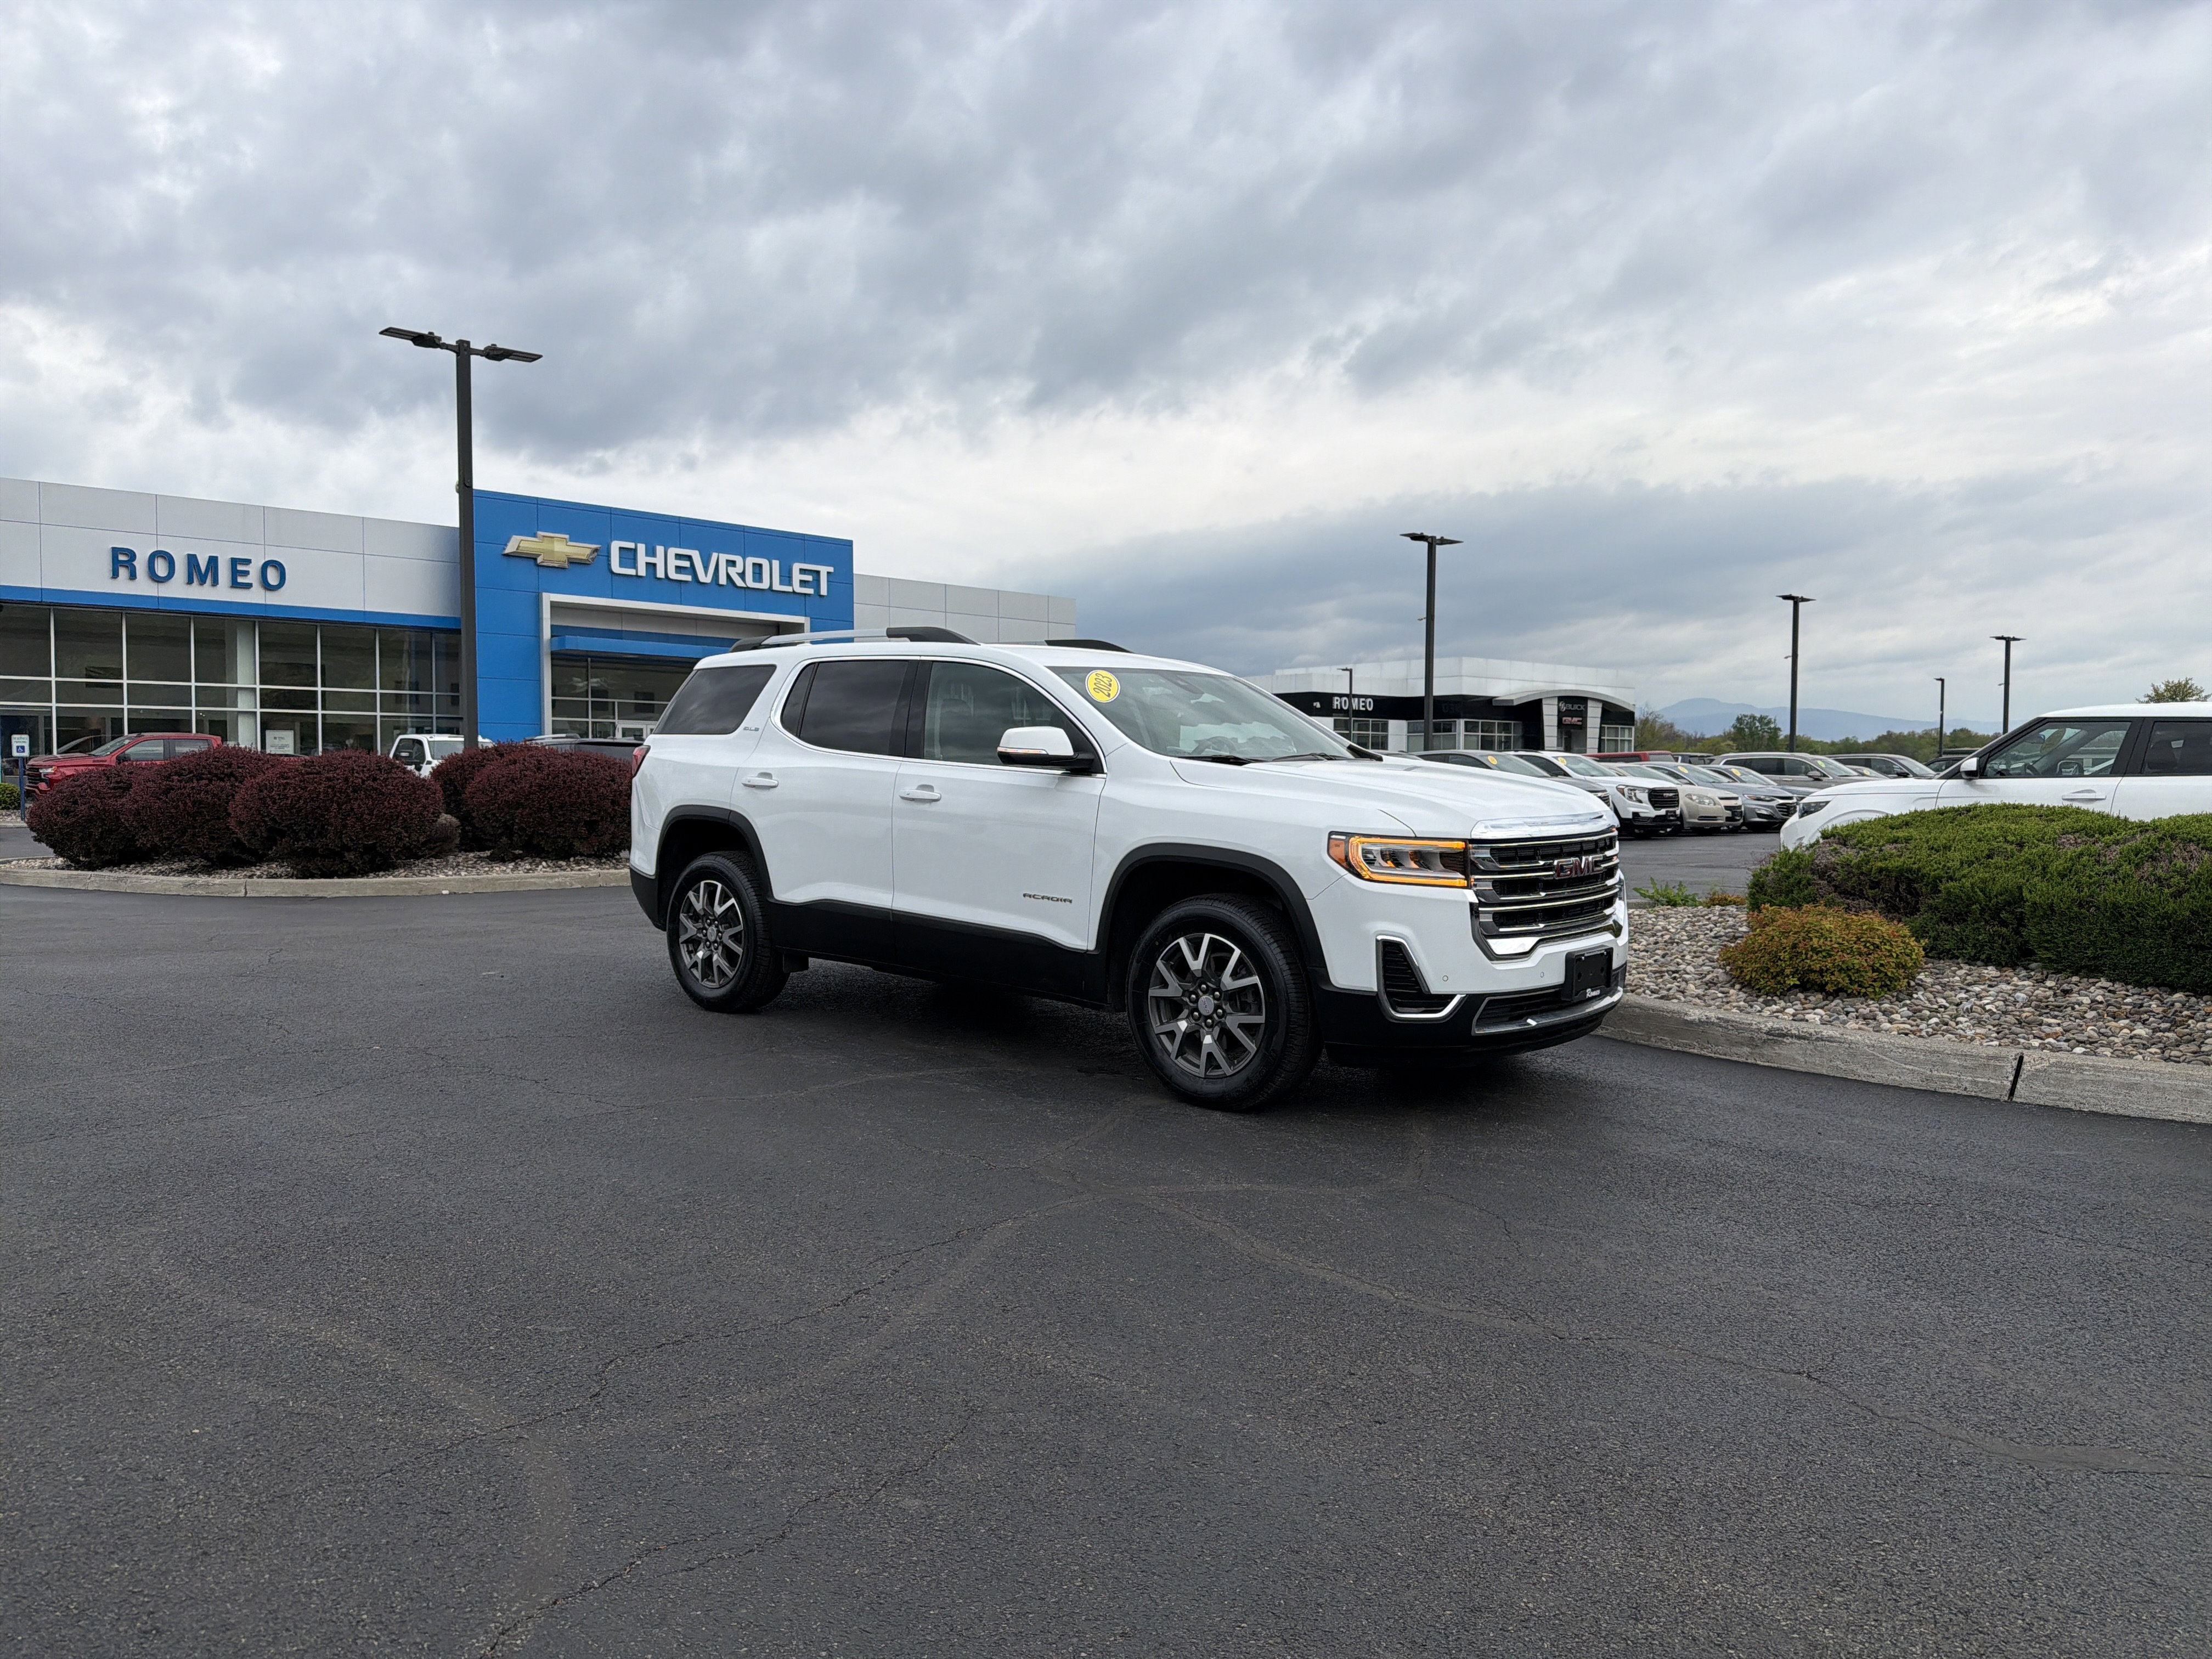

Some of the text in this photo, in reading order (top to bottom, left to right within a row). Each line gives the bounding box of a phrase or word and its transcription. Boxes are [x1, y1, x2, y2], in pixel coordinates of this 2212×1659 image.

[111, 546, 286, 591] ROMEO
[611, 540, 834, 596] CHEVROLET
[1093, 673, 1113, 698] 2023
[1333, 696, 1374, 711] ROMEO
[1562, 716, 1582, 725] GMC
[1554, 854, 1603, 880] GMC
[1023, 893, 1073, 904] ACADIA
